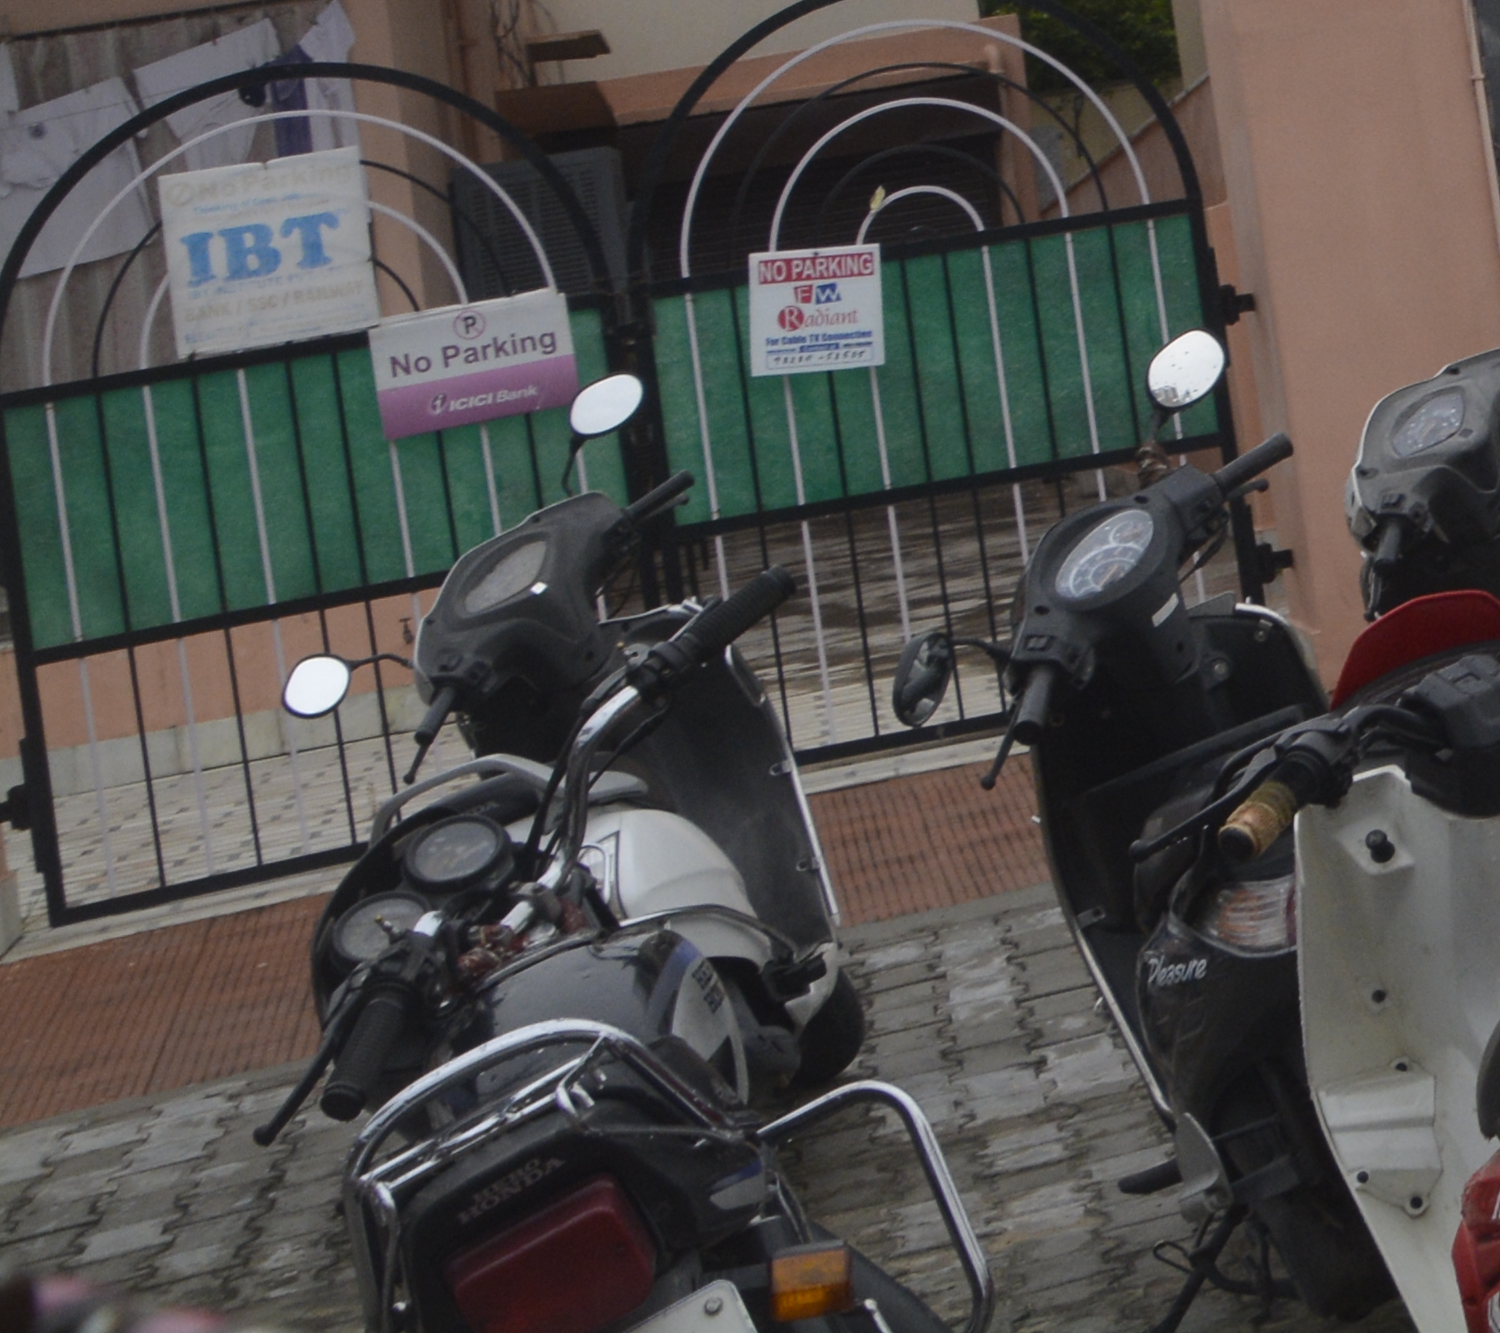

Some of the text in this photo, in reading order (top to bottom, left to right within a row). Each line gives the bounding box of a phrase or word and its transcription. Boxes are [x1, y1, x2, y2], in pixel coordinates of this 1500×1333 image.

[180, 211, 340, 287] IBT
[760, 254, 873, 282] NO PARKING
[778, 306, 859, 331] Radiant
[390, 331, 557, 378] No Parking
[449, 392, 493, 412] ICICI
[496, 385, 538, 404] Bank
[1148, 954, 1207, 987] Pleasure
